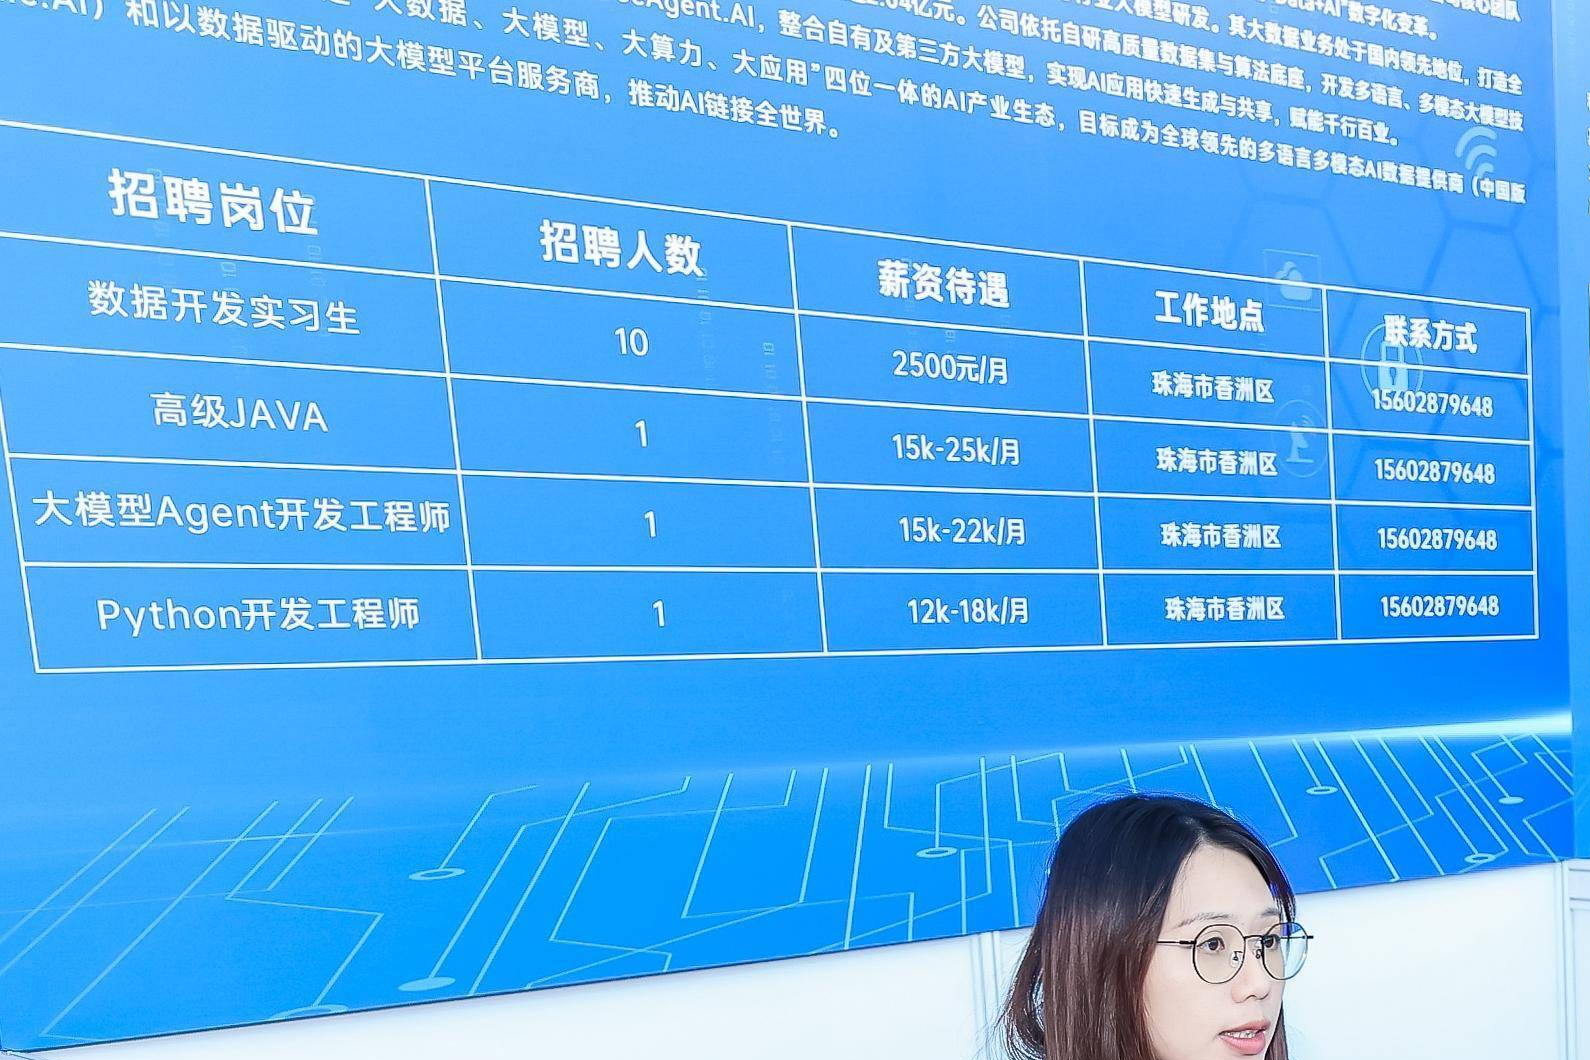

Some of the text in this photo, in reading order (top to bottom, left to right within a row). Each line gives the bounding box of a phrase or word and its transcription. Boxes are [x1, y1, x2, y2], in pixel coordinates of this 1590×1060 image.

[107, 168, 319, 236] 招聘岗位
[539, 219, 704, 277] 招聘人数
[877, 258, 1010, 308] 薪资待遇
[87, 279, 360, 334] 数据开发实习生
[1155, 290, 1265, 333] 工作地点
[614, 327, 649, 356] 10
[1383, 314, 1478, 354] 联系方式
[892, 350, 1008, 385] 2500元/月
[1151, 369, 1275, 403] 珠海市香洲区
[150, 391, 329, 432] 高级JAVA
[1371, 389, 1494, 418] 15602879648
[635, 420, 647, 447] 1
[892, 434, 1020, 466] 15k-25k/月
[1156, 446, 1278, 476] 珠海市香洲区
[1374, 458, 1495, 485] 15602879648
[32, 490, 450, 535] 大模型Agent开发工程师
[644, 511, 656, 538] 1
[899, 516, 1025, 546] 15k-22k/月
[1160, 521, 1282, 549] 珠海市香洲区
[1377, 527, 1498, 551] 15602879648
[97, 597, 420, 637] Python开发工程师
[652, 600, 665, 627] 1
[907, 596, 1028, 625] 12k-18k/月
[1164, 595, 1286, 622] 珠海市香洲区
[1380, 595, 1500, 618] 15602879648
